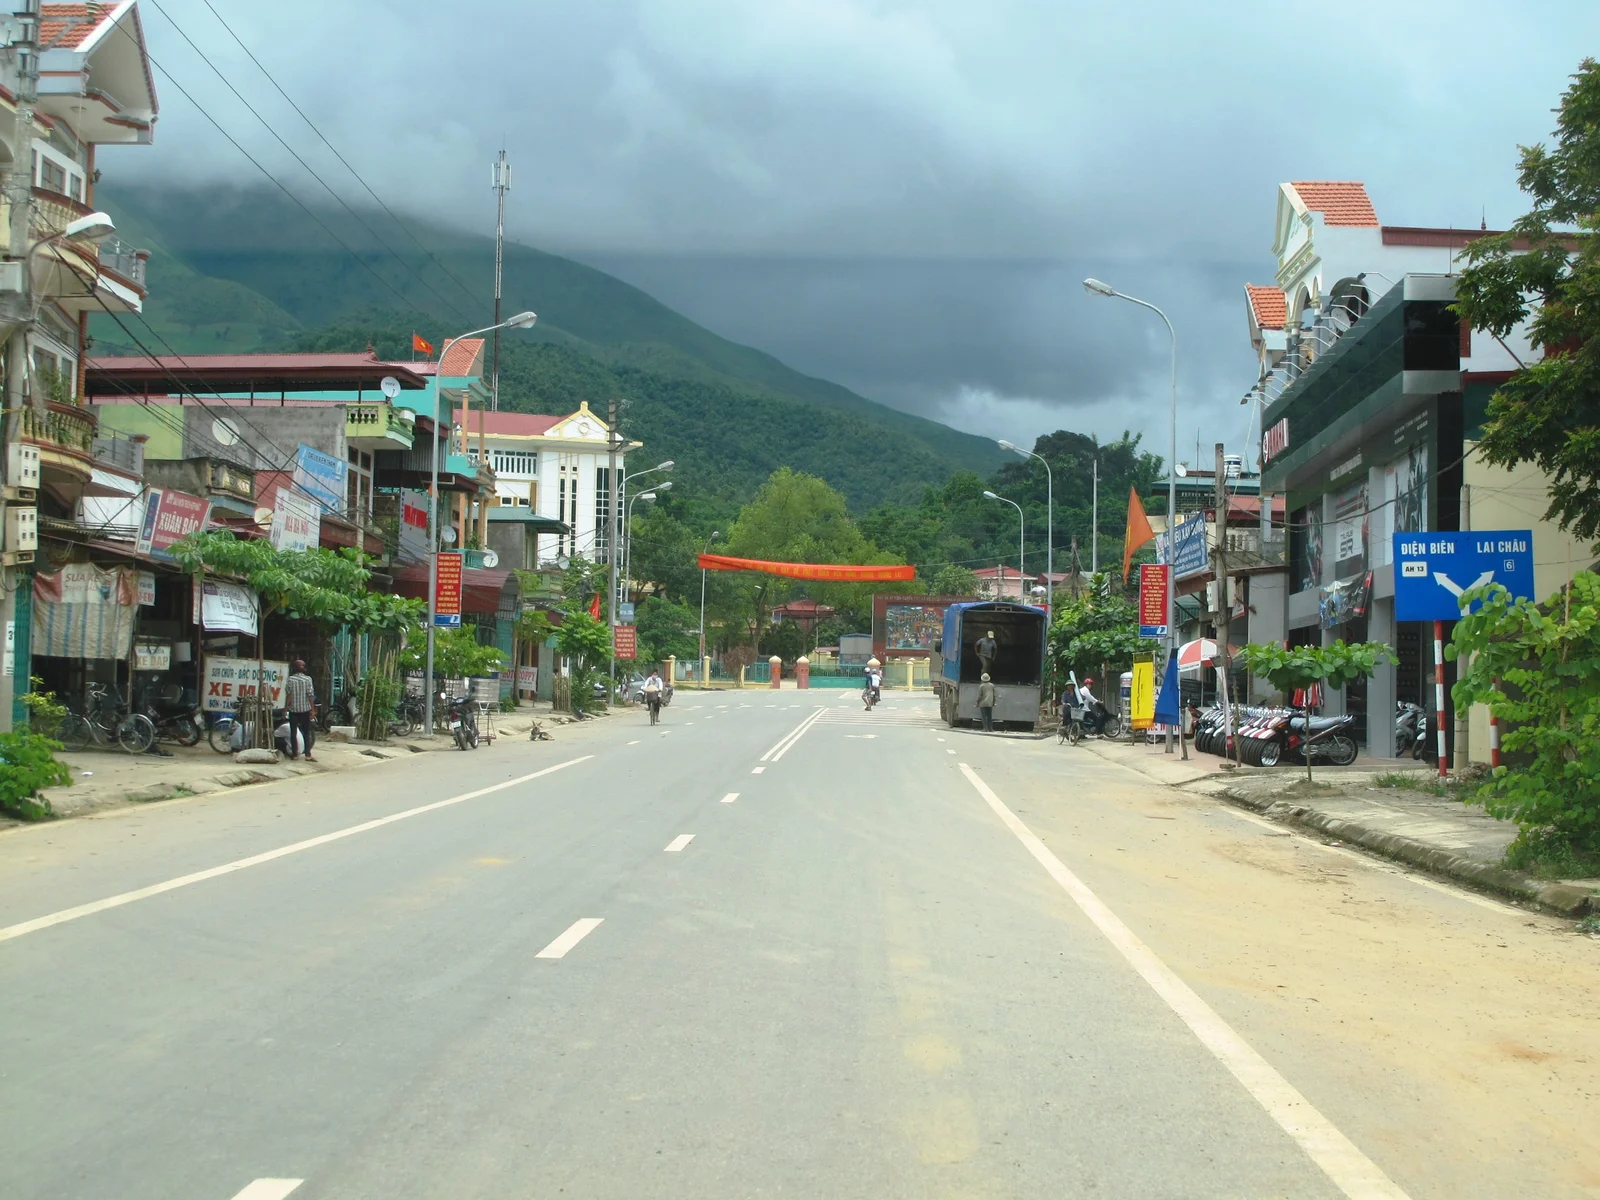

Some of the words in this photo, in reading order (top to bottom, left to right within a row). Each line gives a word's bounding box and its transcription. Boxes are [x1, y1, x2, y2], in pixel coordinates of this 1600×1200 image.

[158, 511, 182, 534] XUÂN
[1401, 541, 1426, 557] ĐIỆN
[1430, 540, 1455, 554] BIÊN
[1477, 541, 1494, 553] LAI
[1498, 538, 1527, 553] CHÂU
[1506, 561, 1513, 570] 6
[208, 682, 233, 698] XE
